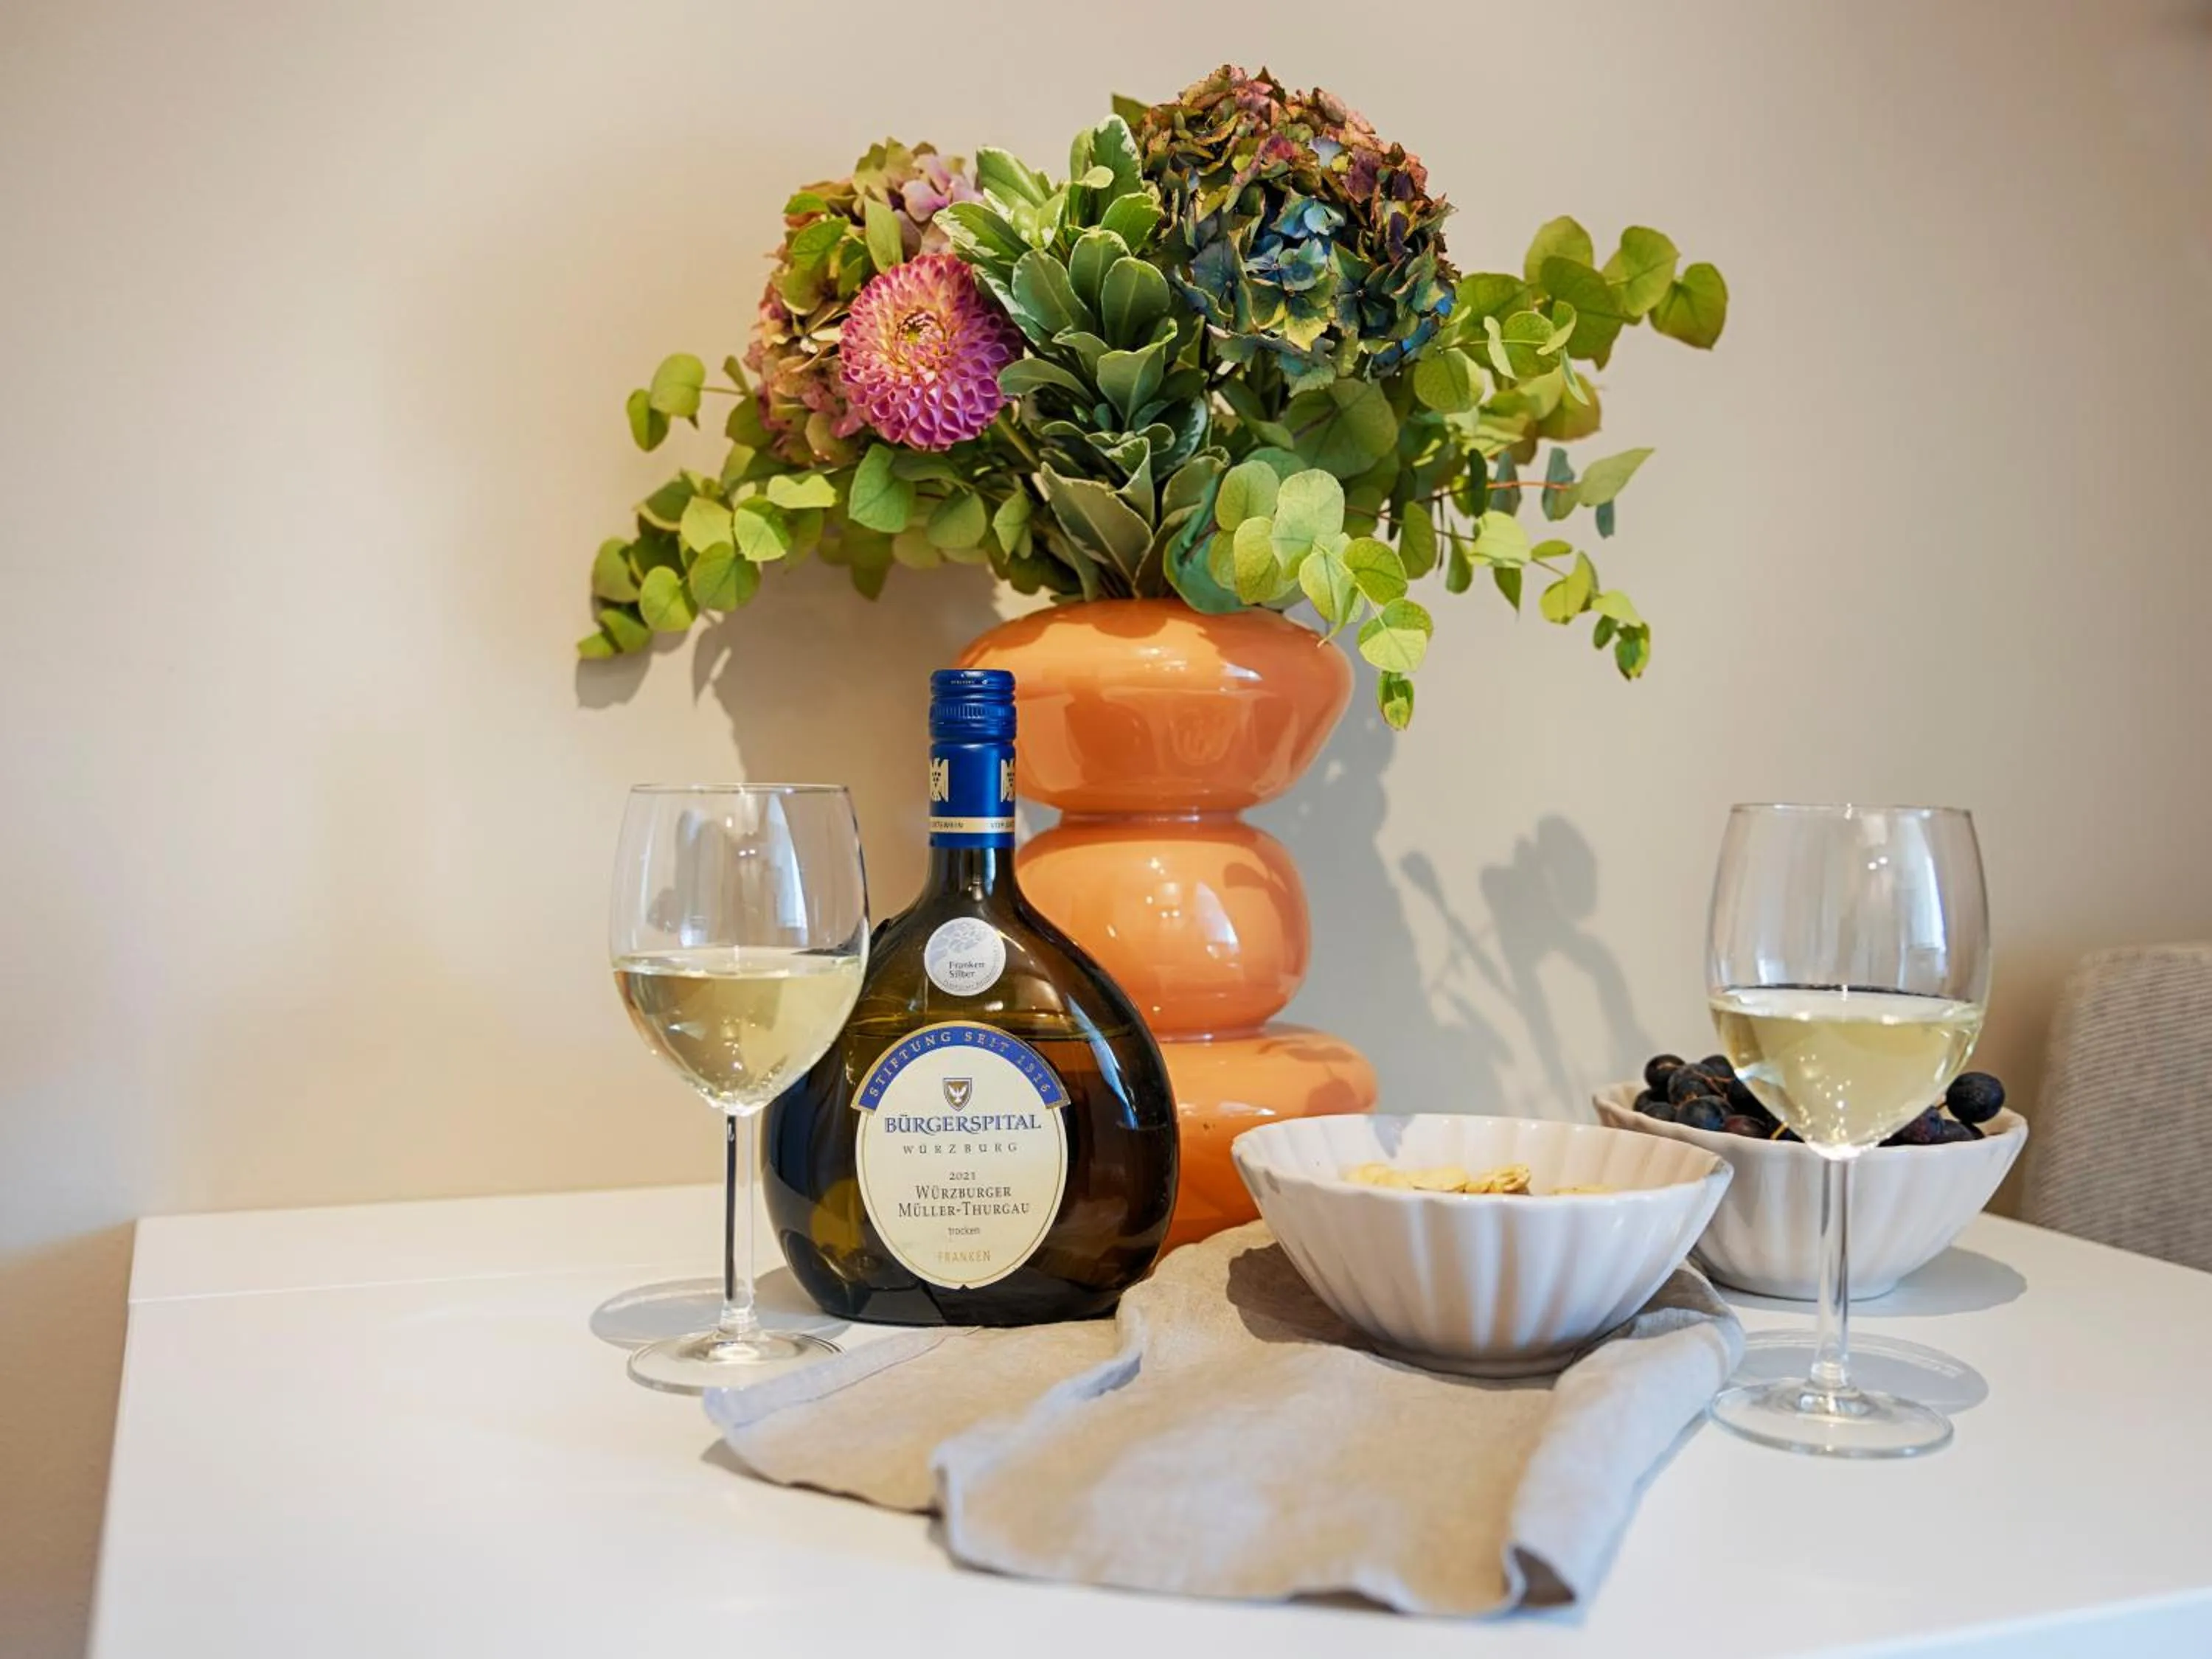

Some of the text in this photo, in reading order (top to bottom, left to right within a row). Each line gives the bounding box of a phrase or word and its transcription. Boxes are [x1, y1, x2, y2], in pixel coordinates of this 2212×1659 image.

[949, 961, 985, 970] Franken
[949, 970, 975, 978] Silber
[868, 1031, 952, 1097] STIFTUNG
[964, 1032, 1012, 1054] SEIT
[884, 1113, 1042, 1136] BÜRGERSPITAL
[949, 1171, 977, 1180] 2021
[915, 1185, 1012, 1200] WÜRZBURGER
[898, 1201, 1030, 1218] MÜLLER-THURGAU
[947, 1226, 981, 1237] trocken
[937, 1250, 991, 1265] FRANKEN
